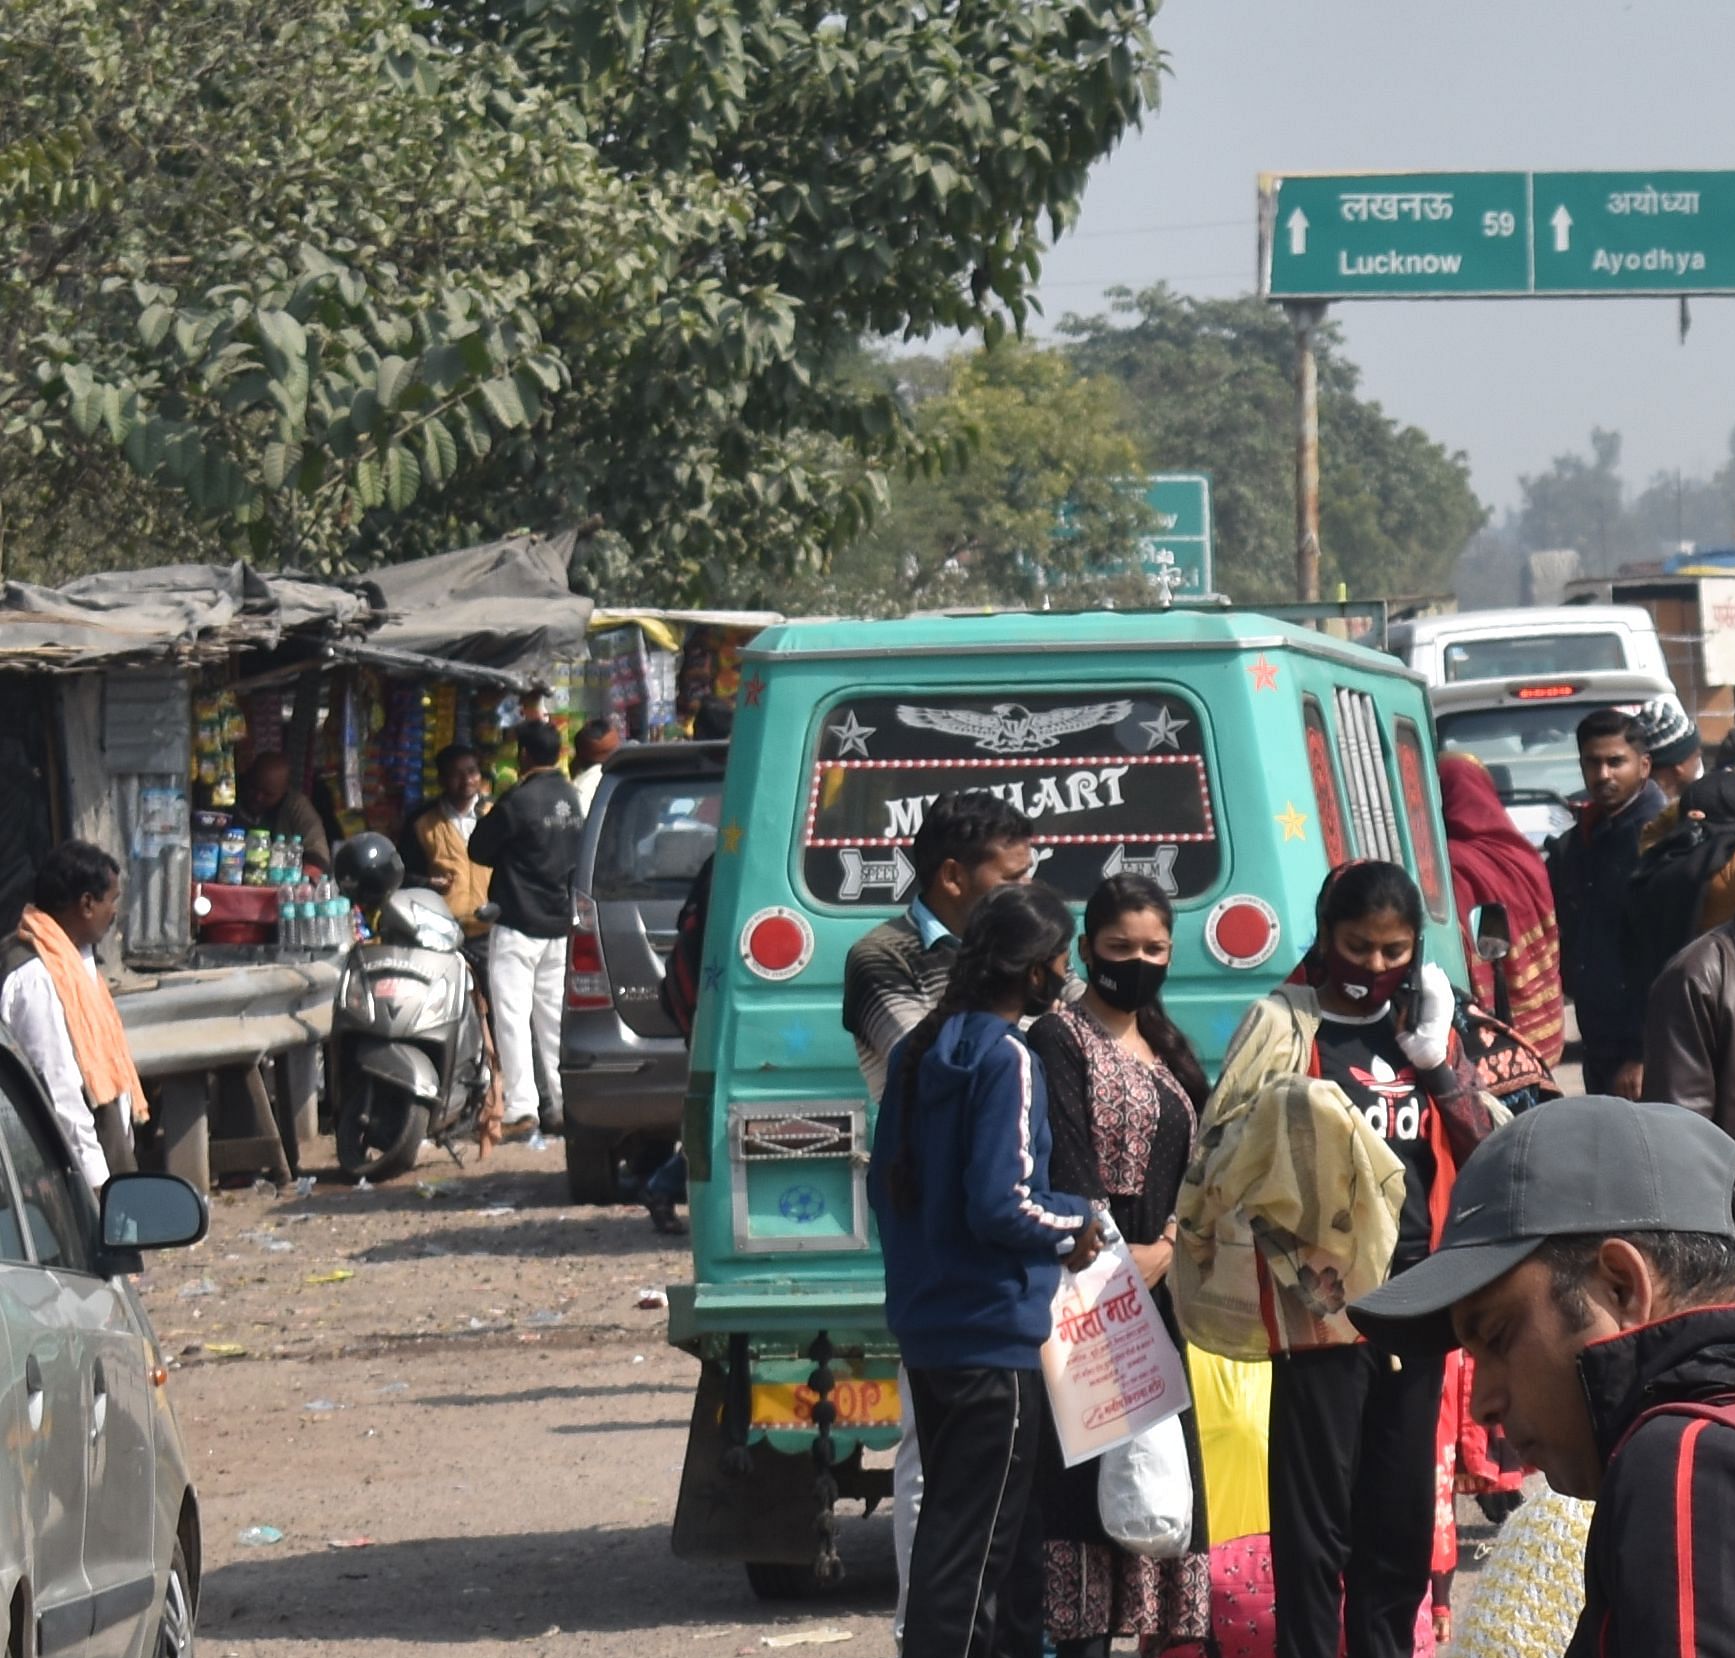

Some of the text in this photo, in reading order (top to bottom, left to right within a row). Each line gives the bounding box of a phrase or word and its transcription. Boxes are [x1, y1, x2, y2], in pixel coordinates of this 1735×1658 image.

[1339, 192, 1453, 221] लखनऊ
[1608, 184, 1701, 215] अयोध्या
[1482, 210, 1516, 237] 59
[1339, 250, 1462, 275] Lucknow
[1592, 248, 1706, 276] Ayodhya
[860, 863, 900, 882] SPEED
[1056, 1275, 1143, 1345] गीता मार्ट
[793, 1381, 882, 1420] SOP
